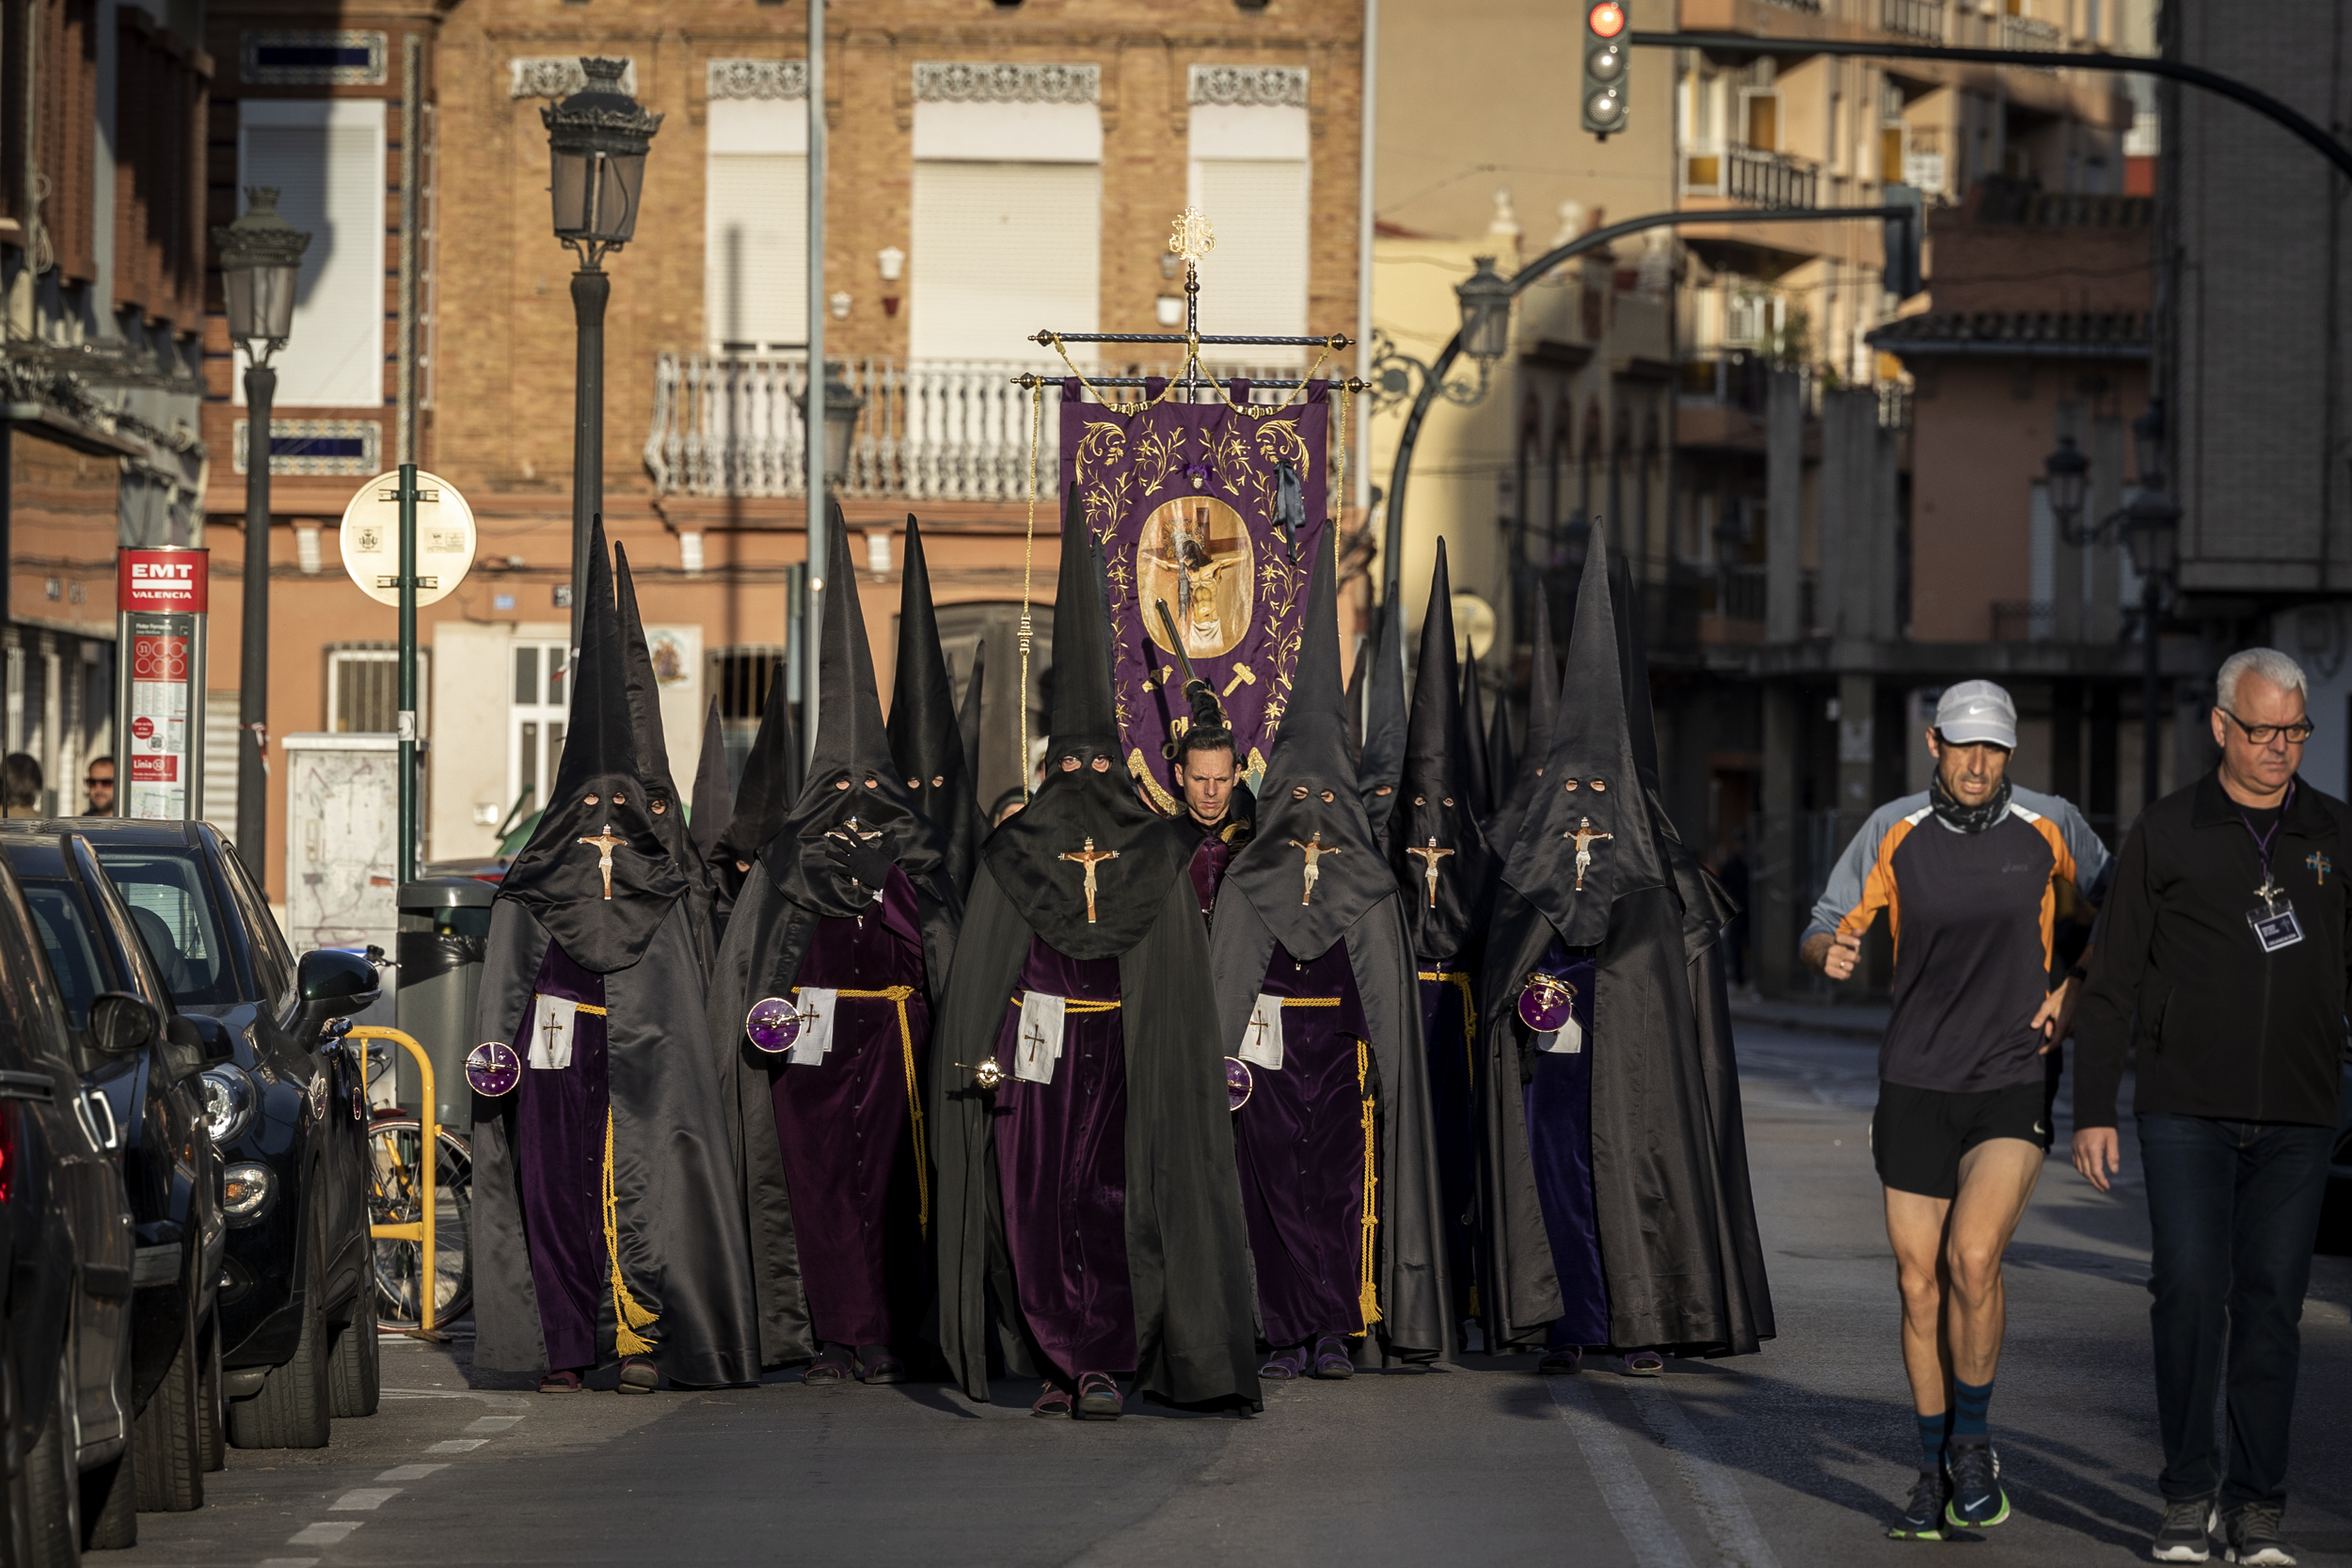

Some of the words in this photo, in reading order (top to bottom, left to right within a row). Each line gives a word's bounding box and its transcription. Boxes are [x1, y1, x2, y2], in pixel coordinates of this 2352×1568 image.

[132, 563, 193, 578] EMT
[132, 591, 192, 599] VALENCIA
[139, 644, 149, 654] 31
